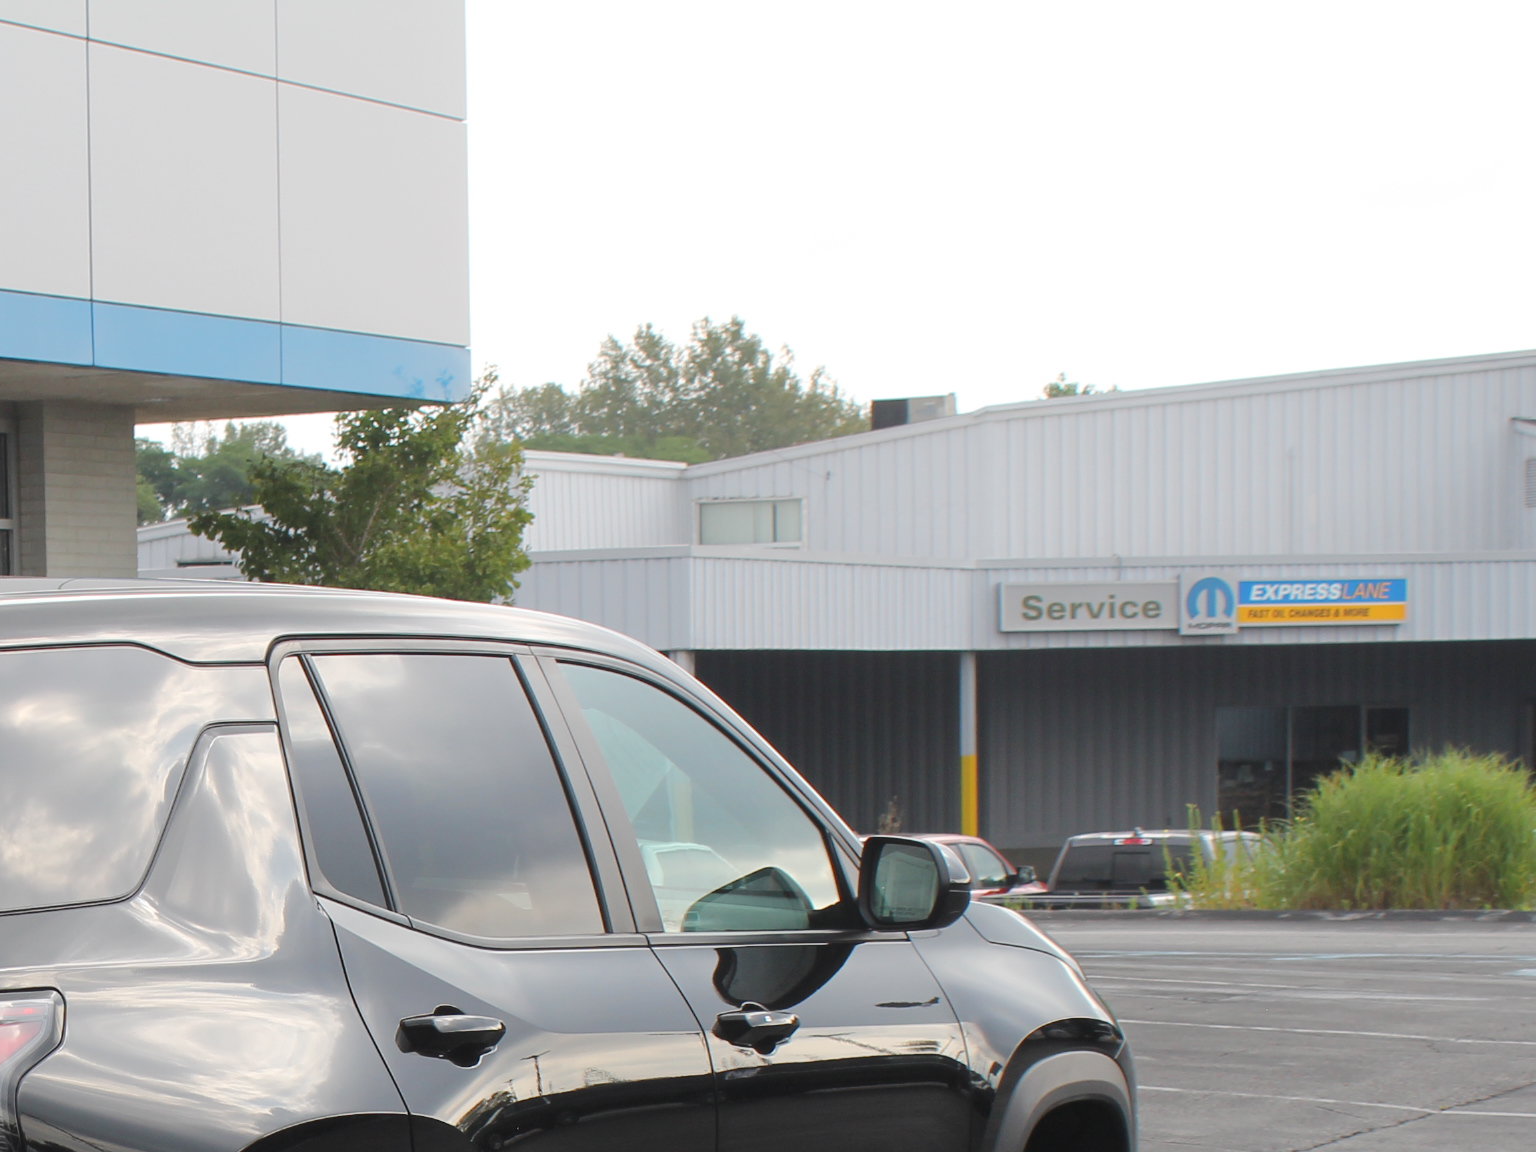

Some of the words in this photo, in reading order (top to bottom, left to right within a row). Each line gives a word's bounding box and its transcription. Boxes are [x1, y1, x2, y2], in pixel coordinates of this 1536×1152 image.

[1021, 594, 1162, 621] Service
[1248, 609, 1270, 619] FAST
[1271, 609, 1286, 618] OIL
[1289, 608, 1331, 618] CHANGES
[1343, 607, 1370, 617] MORE
